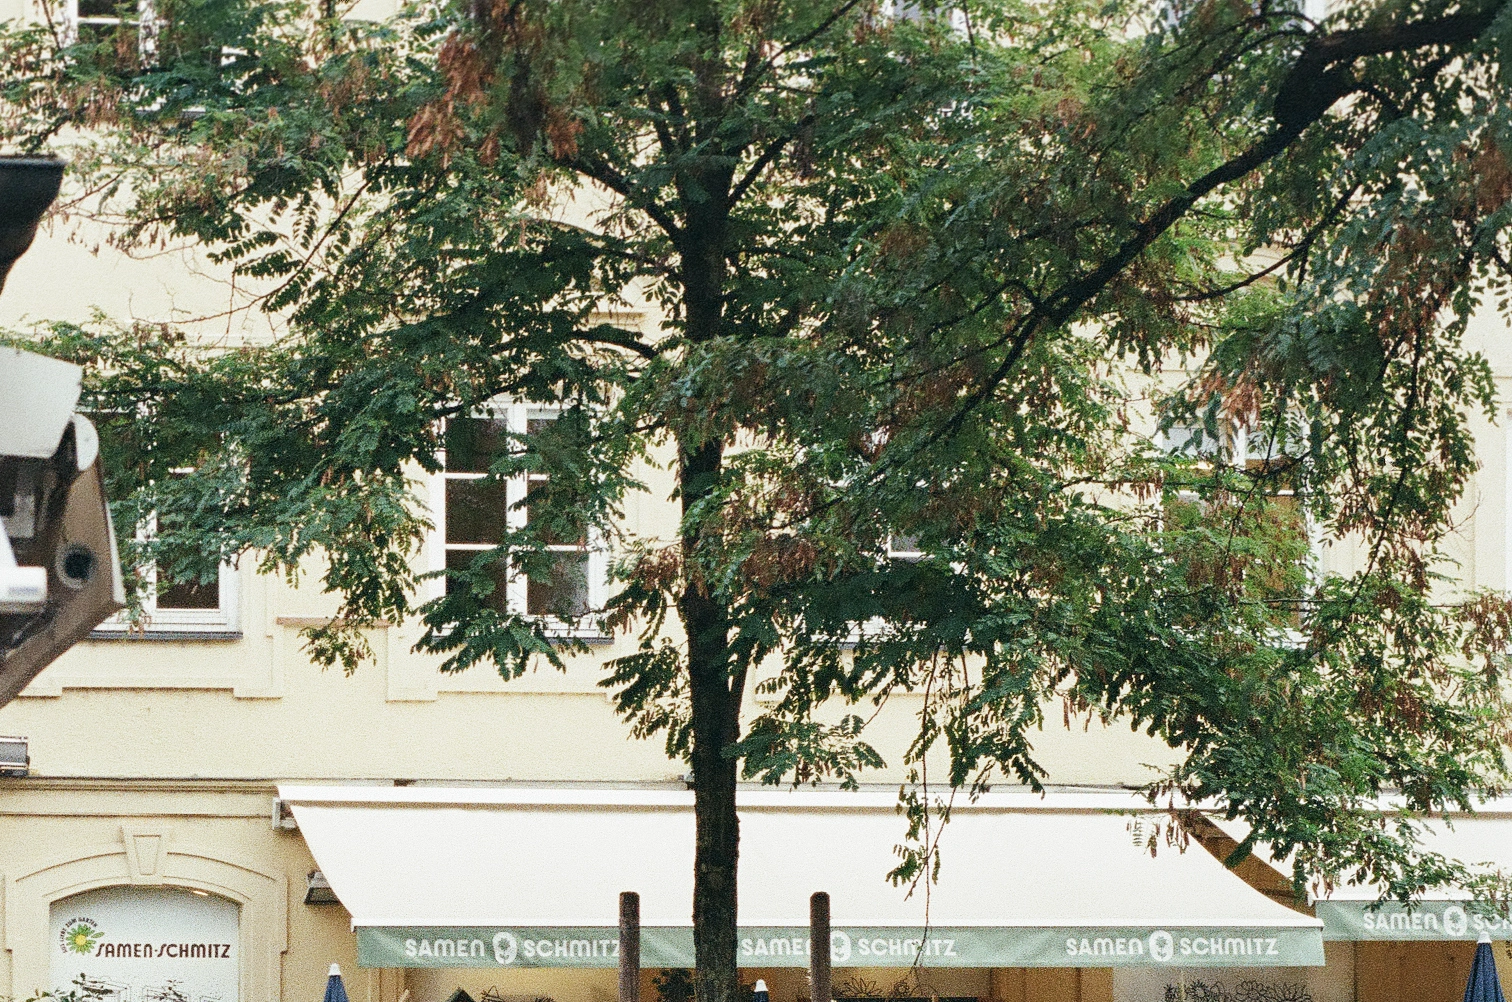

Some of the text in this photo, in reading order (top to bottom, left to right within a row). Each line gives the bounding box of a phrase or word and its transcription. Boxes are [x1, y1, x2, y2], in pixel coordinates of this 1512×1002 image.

[1362, 912, 1439, 931] SAMEN
[404, 938, 620, 958] SAMEN SCHMITZ
[1065, 936, 1279, 956] SAMEN SCHMITZ
